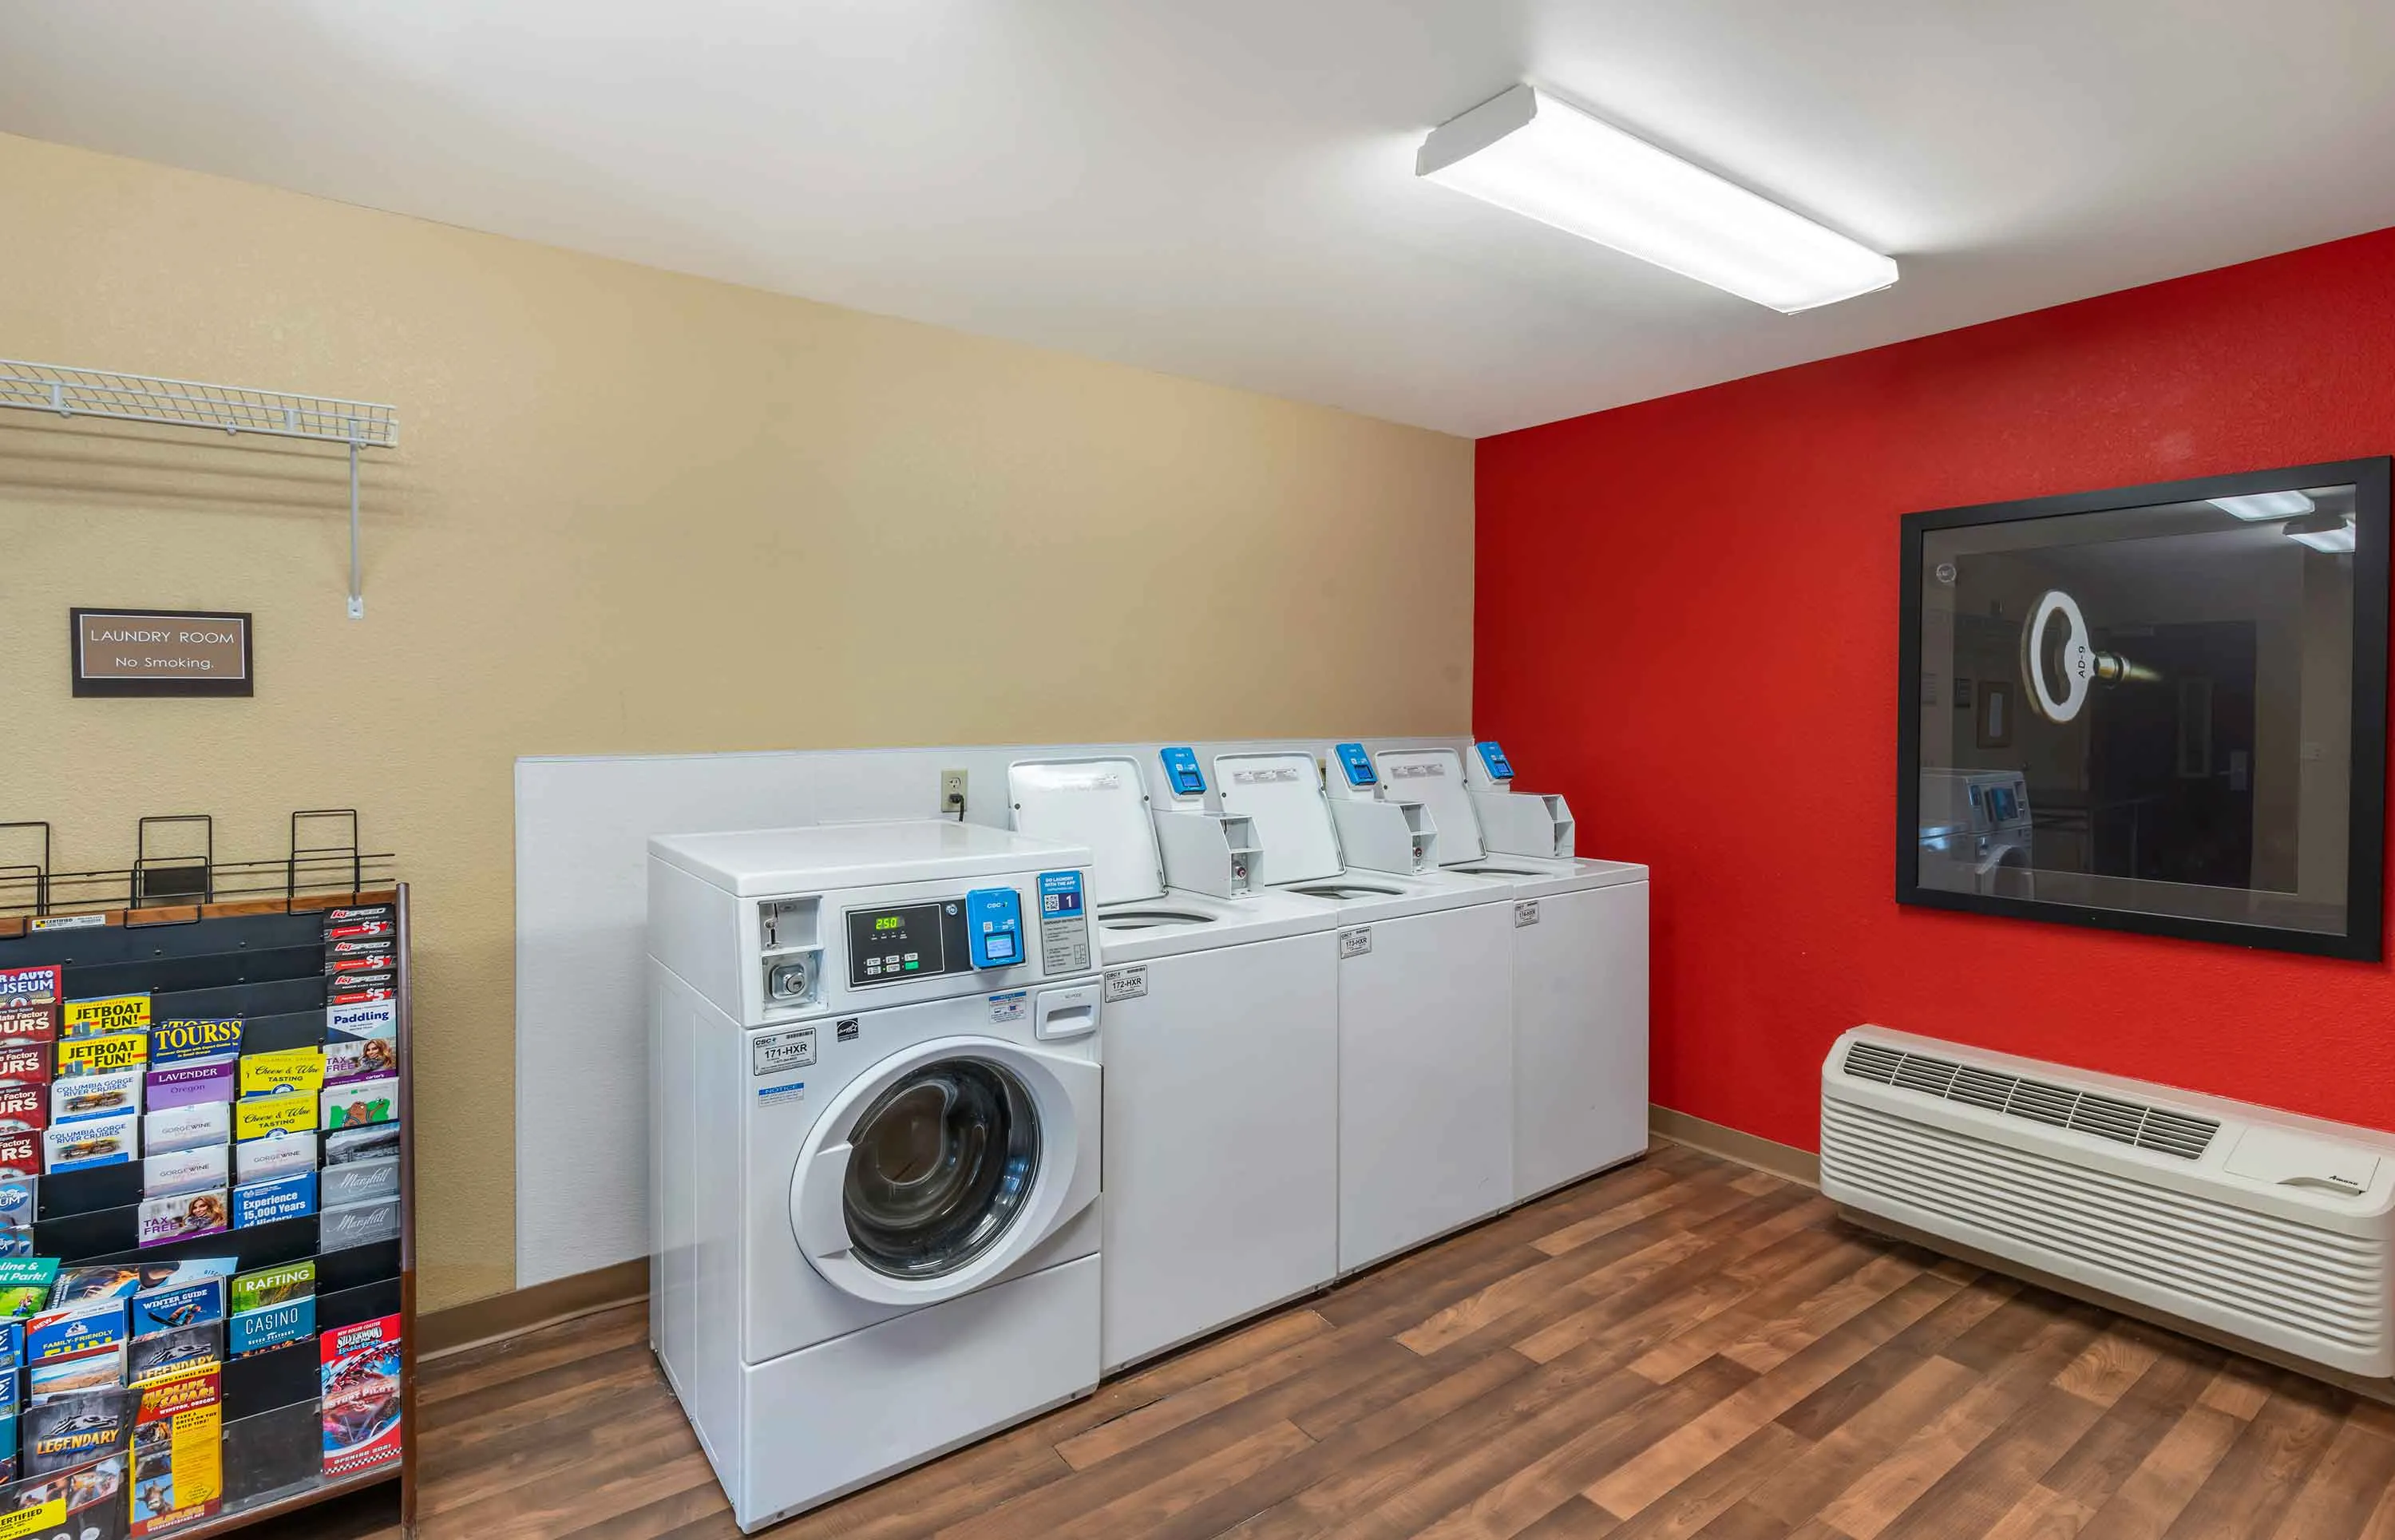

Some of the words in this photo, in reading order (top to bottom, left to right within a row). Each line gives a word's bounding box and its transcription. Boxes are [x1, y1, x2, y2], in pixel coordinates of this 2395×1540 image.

[91, 630, 171, 642] LAUNDRY
[180, 631, 234, 643] ROOM
[116, 657, 137, 667] No
[144, 657, 214, 671] Smoking.
[1066, 895, 1072, 908] 1
[362, 920, 380, 935] $5
[366, 955, 384, 968] $5
[18, 970, 53, 981] AUTO
[17, 1011, 48, 1019] Factory
[76, 1003, 143, 1020] JETBOAT
[334, 1011, 390, 1024] Paddling
[0, 1018, 49, 1034] URS
[102, 1014, 138, 1028] FUN!
[6, 1051, 38, 1061] Factory
[69, 1040, 137, 1059] JETBOAT
[766, 1043, 807, 1059] 171-HXR
[94, 1052, 132, 1067] FUN!
[327, 1056, 346, 1065] TAX
[327, 1063, 355, 1072] FREE
[160, 1068, 217, 1083] LAVENDER
[57, 1082, 102, 1093] COLUMBIA
[105, 1077, 133, 1087] GORGE
[64, 1089, 89, 1098] RIVER
[91, 1084, 128, 1093] CRUISES
[4, 1091, 37, 1101] Factory
[259, 1118, 295, 1128] TASTING
[49, 1129, 94, 1140] COLUMBIA
[97, 1123, 126, 1133] GORGE
[84, 1130, 120, 1140] CRUISES
[243, 1192, 298, 1209] Experience
[243, 1205, 277, 1220] 15,000
[279, 1201, 306, 1213] Years
[144, 1216, 168, 1227] TAX
[144, 1222, 177, 1235] FREE
[10, 1272, 47, 1281] Park!
[246, 1270, 310, 1291] RAFTING
[143, 1296, 180, 1309] WINTER
[182, 1289, 208, 1300] GUIDE
[34, 1317, 53, 1330] NEW
[246, 1308, 298, 1334] CASINO
[43, 1329, 113, 1348] FAMILY-FRIENDLY
[337, 1326, 382, 1348] SILVERWOOD
[37, 1429, 119, 1455] LEGENDARY
[1, 1508, 43, 1526] ERTIFIED
